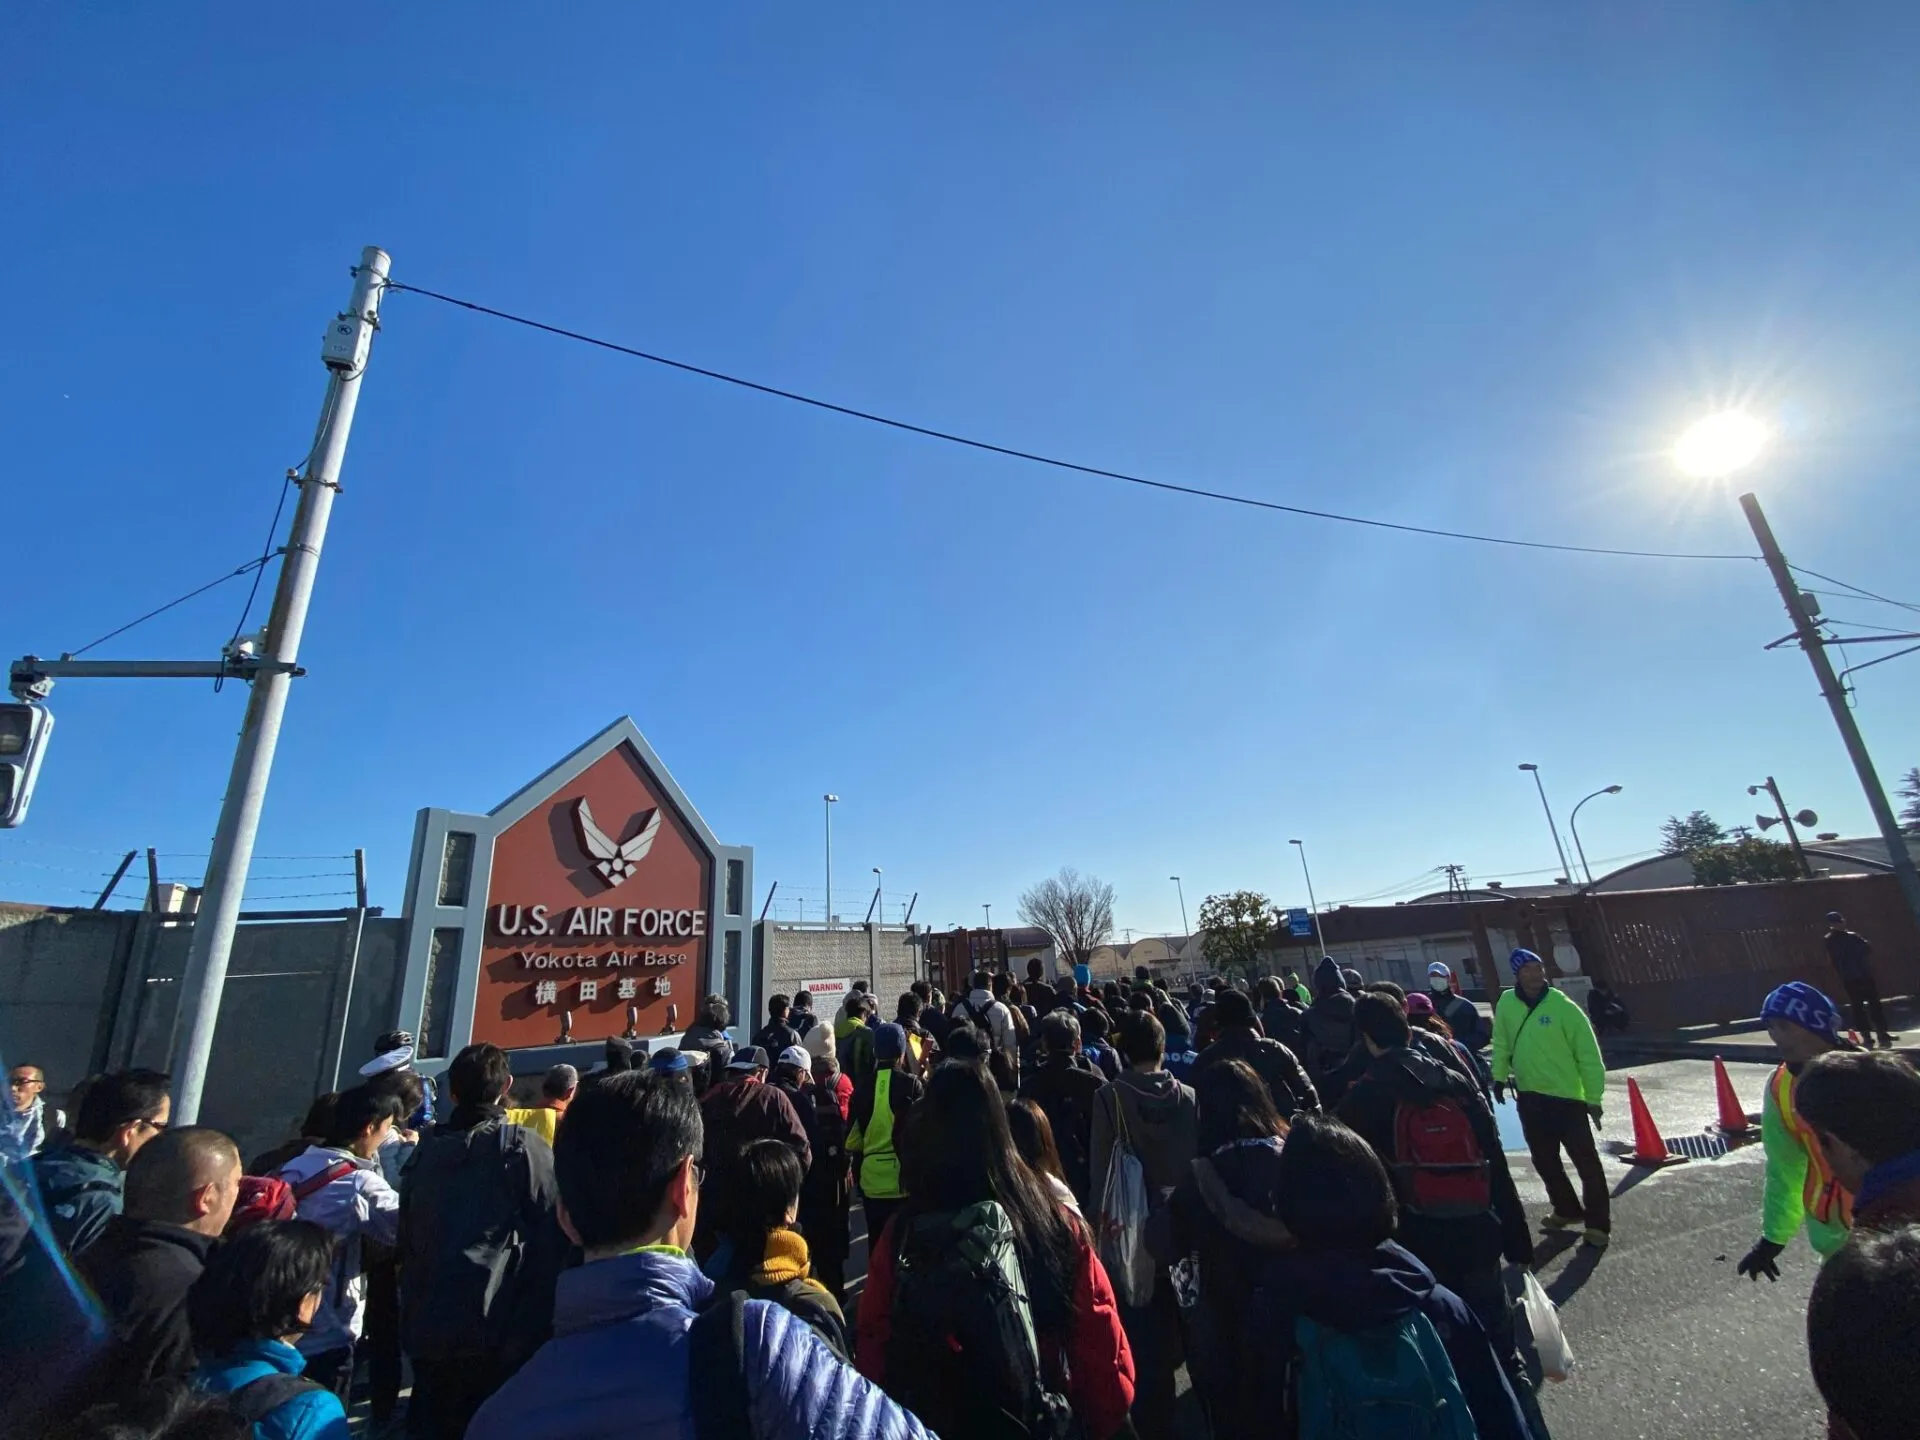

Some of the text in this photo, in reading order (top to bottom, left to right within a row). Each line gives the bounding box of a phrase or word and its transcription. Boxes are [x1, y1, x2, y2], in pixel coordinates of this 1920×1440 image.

[500, 904, 705, 936] U.S. AIR FORCE
[521, 950, 687, 969] Yokota Air Base
[535, 976, 671, 1005] 横田基地
[809, 983, 843, 992] WARNING
